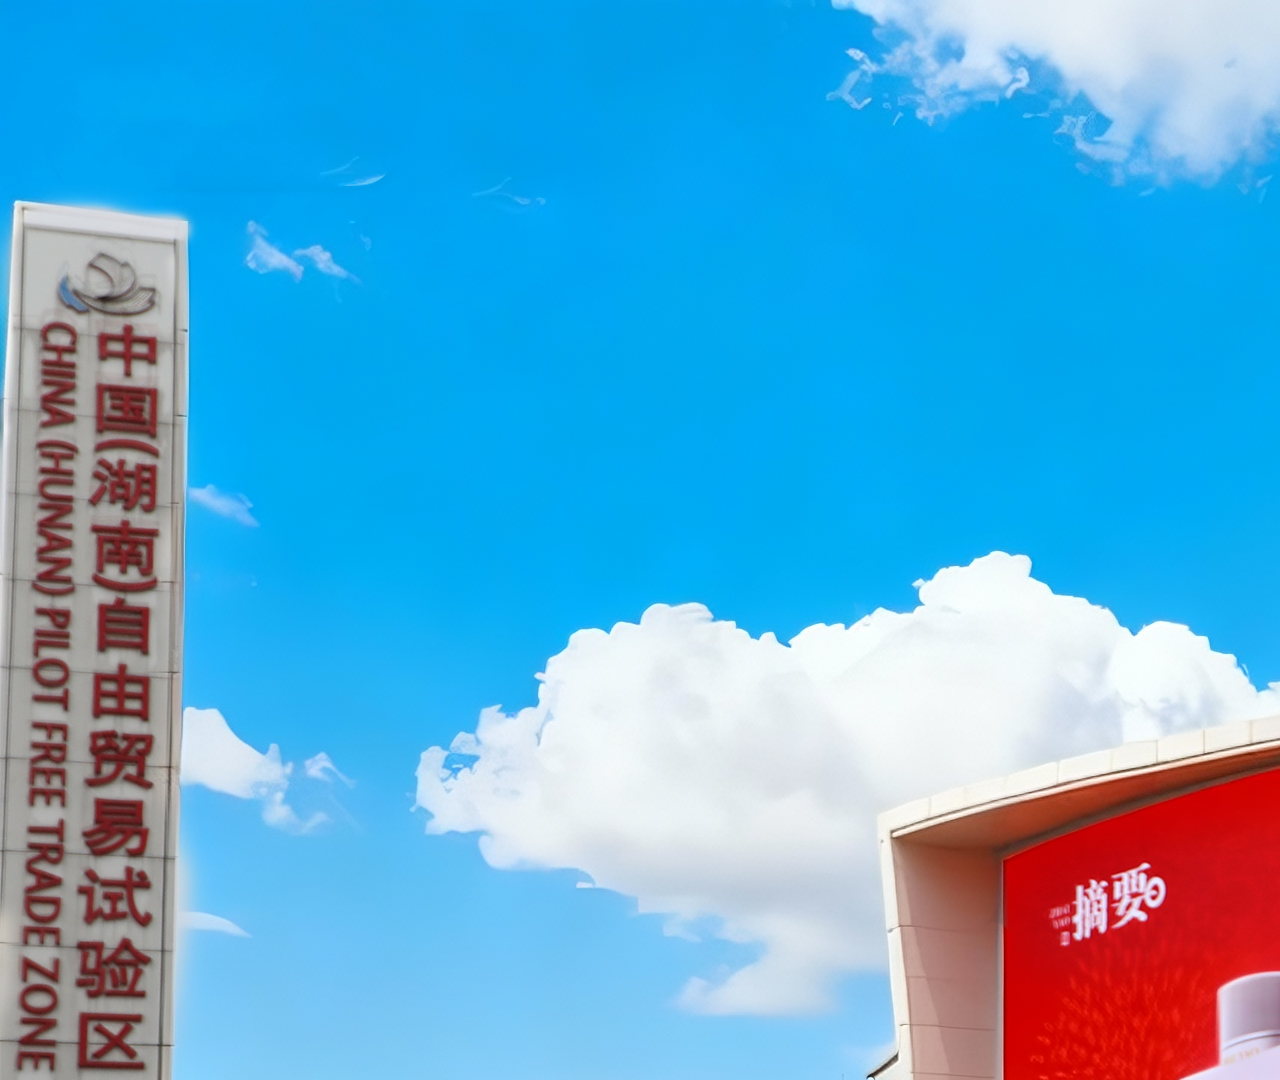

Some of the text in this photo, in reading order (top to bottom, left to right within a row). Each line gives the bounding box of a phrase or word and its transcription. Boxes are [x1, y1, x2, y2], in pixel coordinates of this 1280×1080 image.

[16, 320, 79, 1071] CHINA (HUNAN) PILOT FREE TRADE ZONE
[1072, 862, 1152, 941] 摘要
